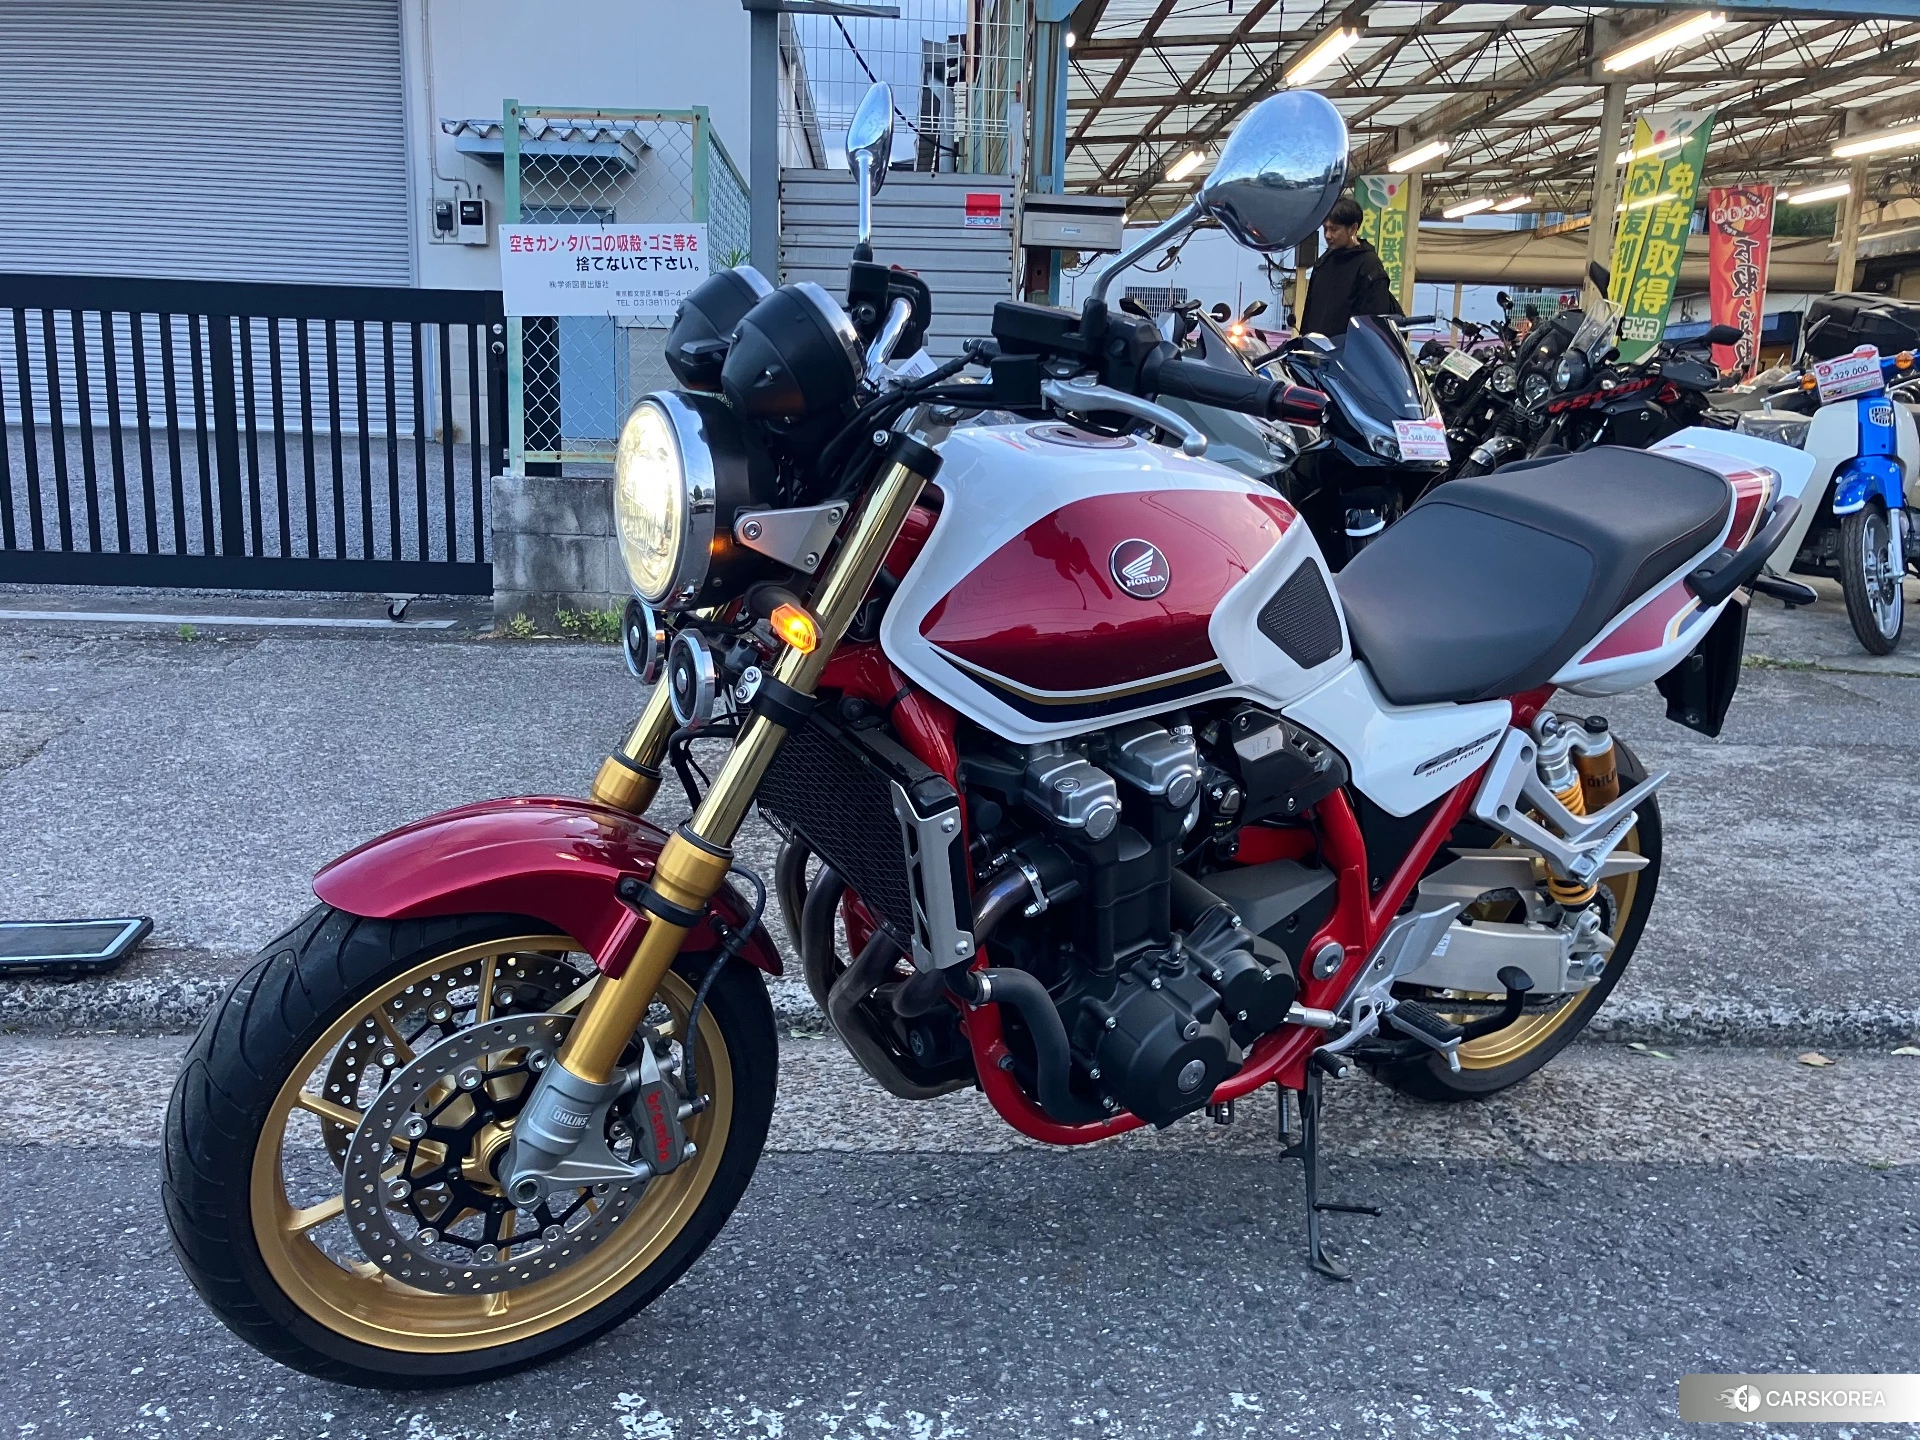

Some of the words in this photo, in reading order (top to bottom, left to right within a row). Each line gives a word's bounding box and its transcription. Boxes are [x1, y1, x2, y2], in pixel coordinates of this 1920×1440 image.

[966, 217, 999, 225] SECOM
[509, 234, 698, 253] 空きカン・タバコの吸殻・ゴミ等を
[1631, 163, 1695, 315] 免許取得
[576, 255, 699, 272] 捨てないで下さい。
[633, 299, 682, 307] 03(3811)08
[1622, 319, 1658, 333] OYA
[1126, 575, 1165, 587] HONDA
[1425, 758, 1458, 777] SUPER
[1459, 745, 1484, 762] FOUR
[646, 1090, 673, 1162] brembo
